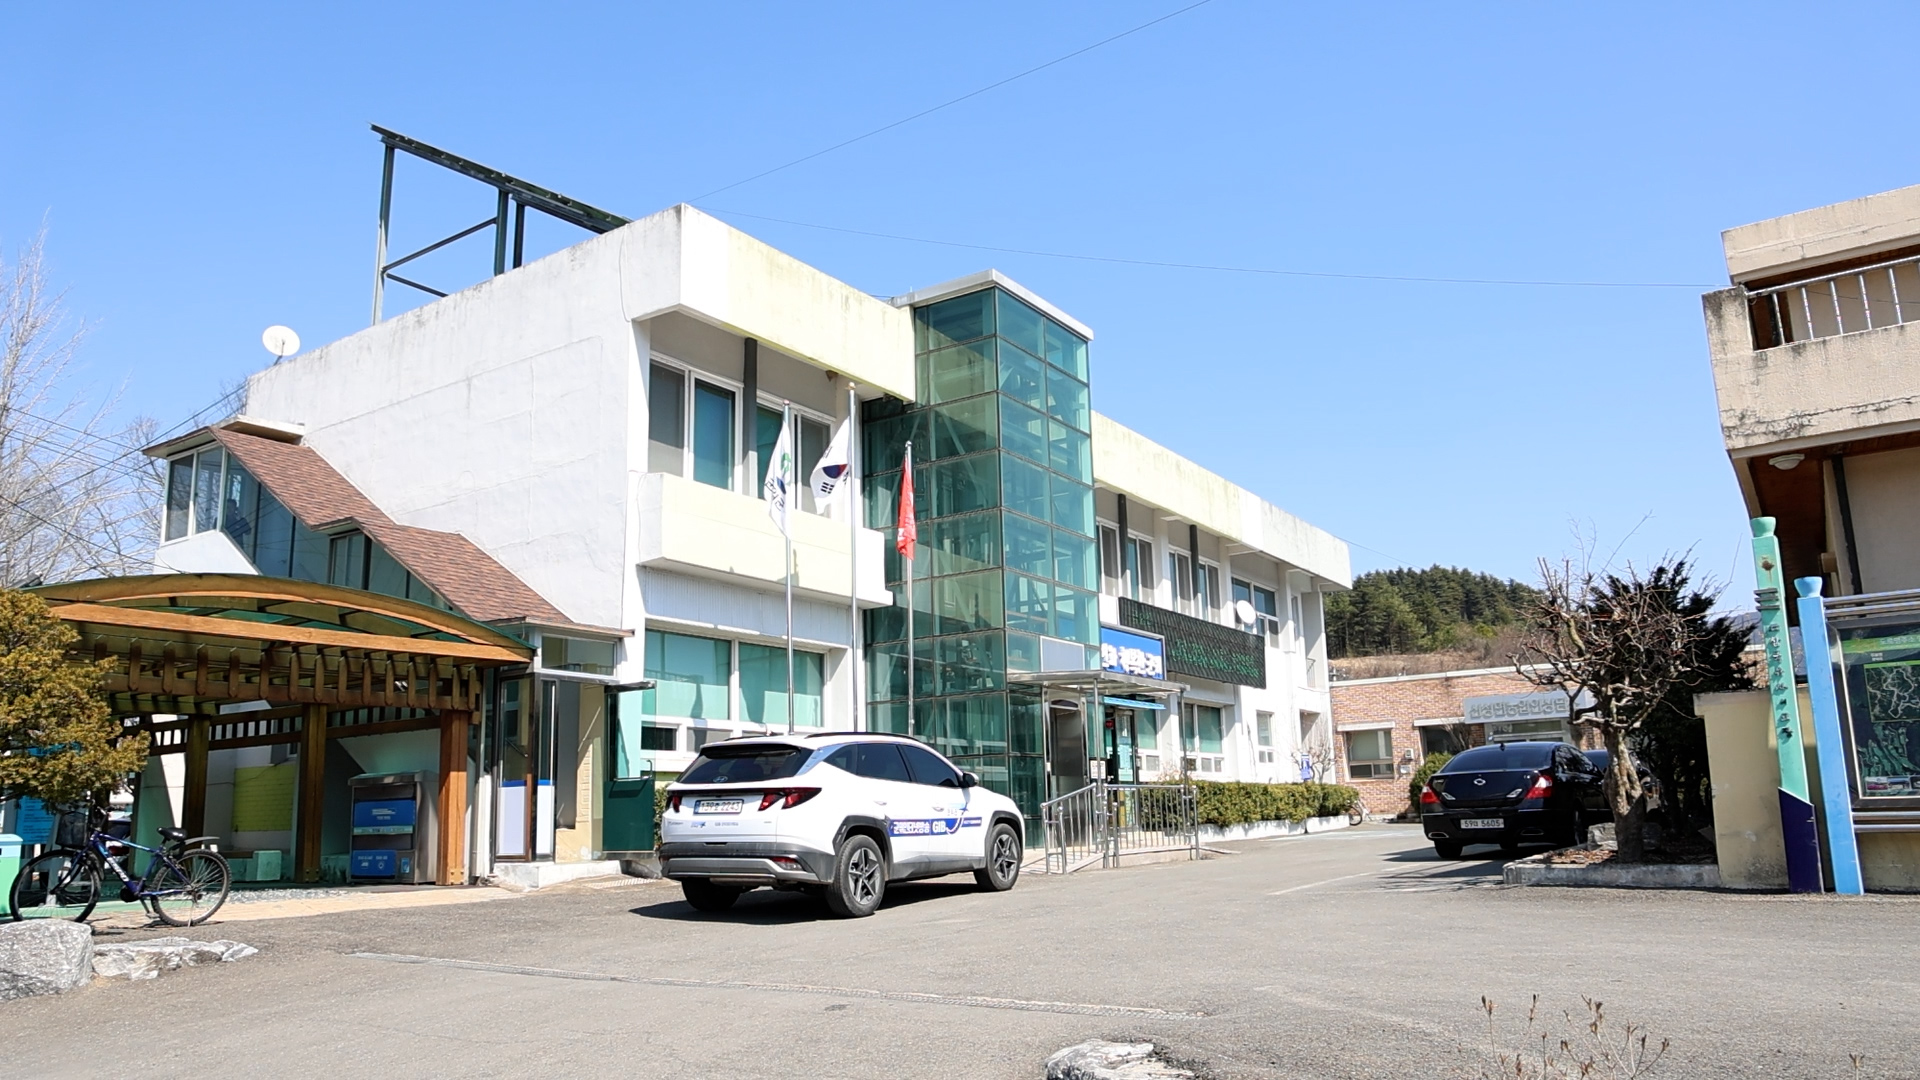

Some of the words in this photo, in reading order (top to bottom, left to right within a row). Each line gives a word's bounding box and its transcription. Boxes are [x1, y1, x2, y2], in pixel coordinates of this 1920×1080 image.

[721, 801, 741, 812] 2243
[932, 820, 947, 833] GIB
[1480, 819, 1501, 828] 5605
